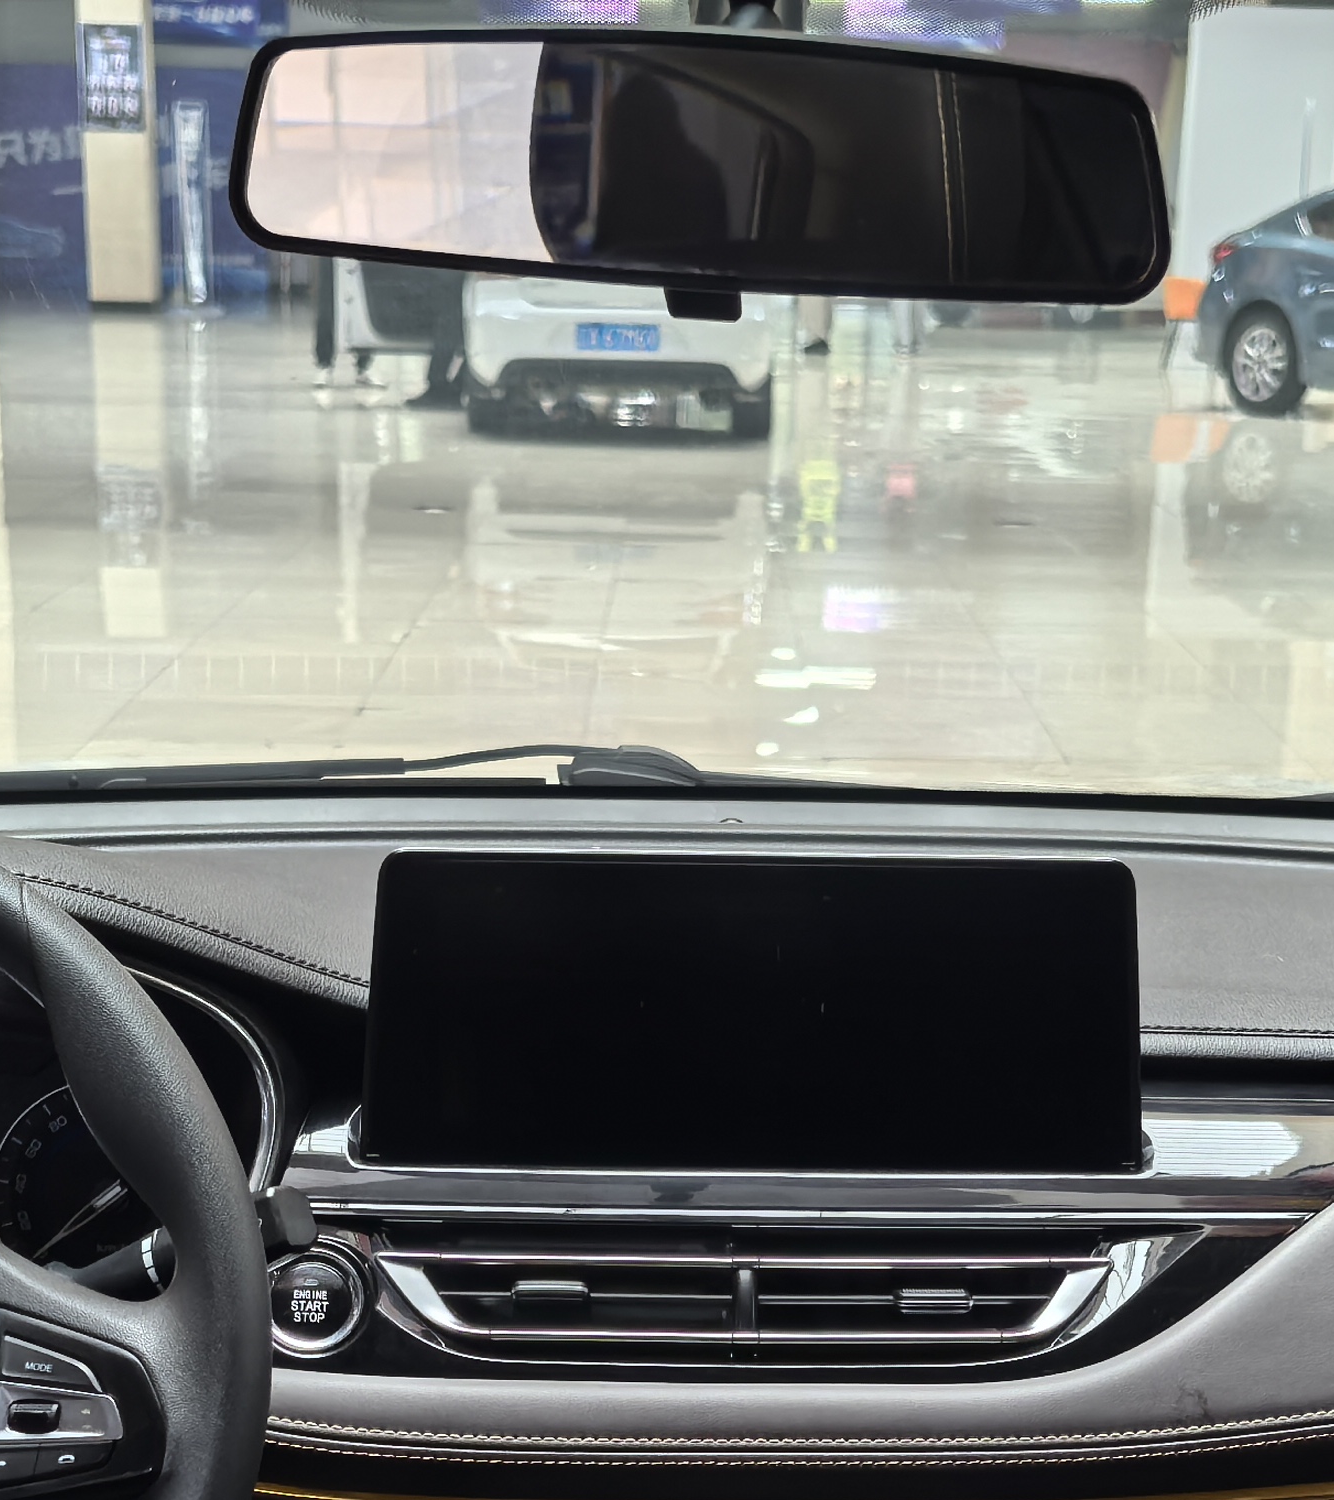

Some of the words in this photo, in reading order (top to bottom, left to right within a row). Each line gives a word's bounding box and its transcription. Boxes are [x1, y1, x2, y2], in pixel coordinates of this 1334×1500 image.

[293, 1289, 328, 1300] ENGINE
[291, 1300, 330, 1312] START
[293, 1312, 325, 1323] STOP
[24, 1361, 53, 1373] MODE
